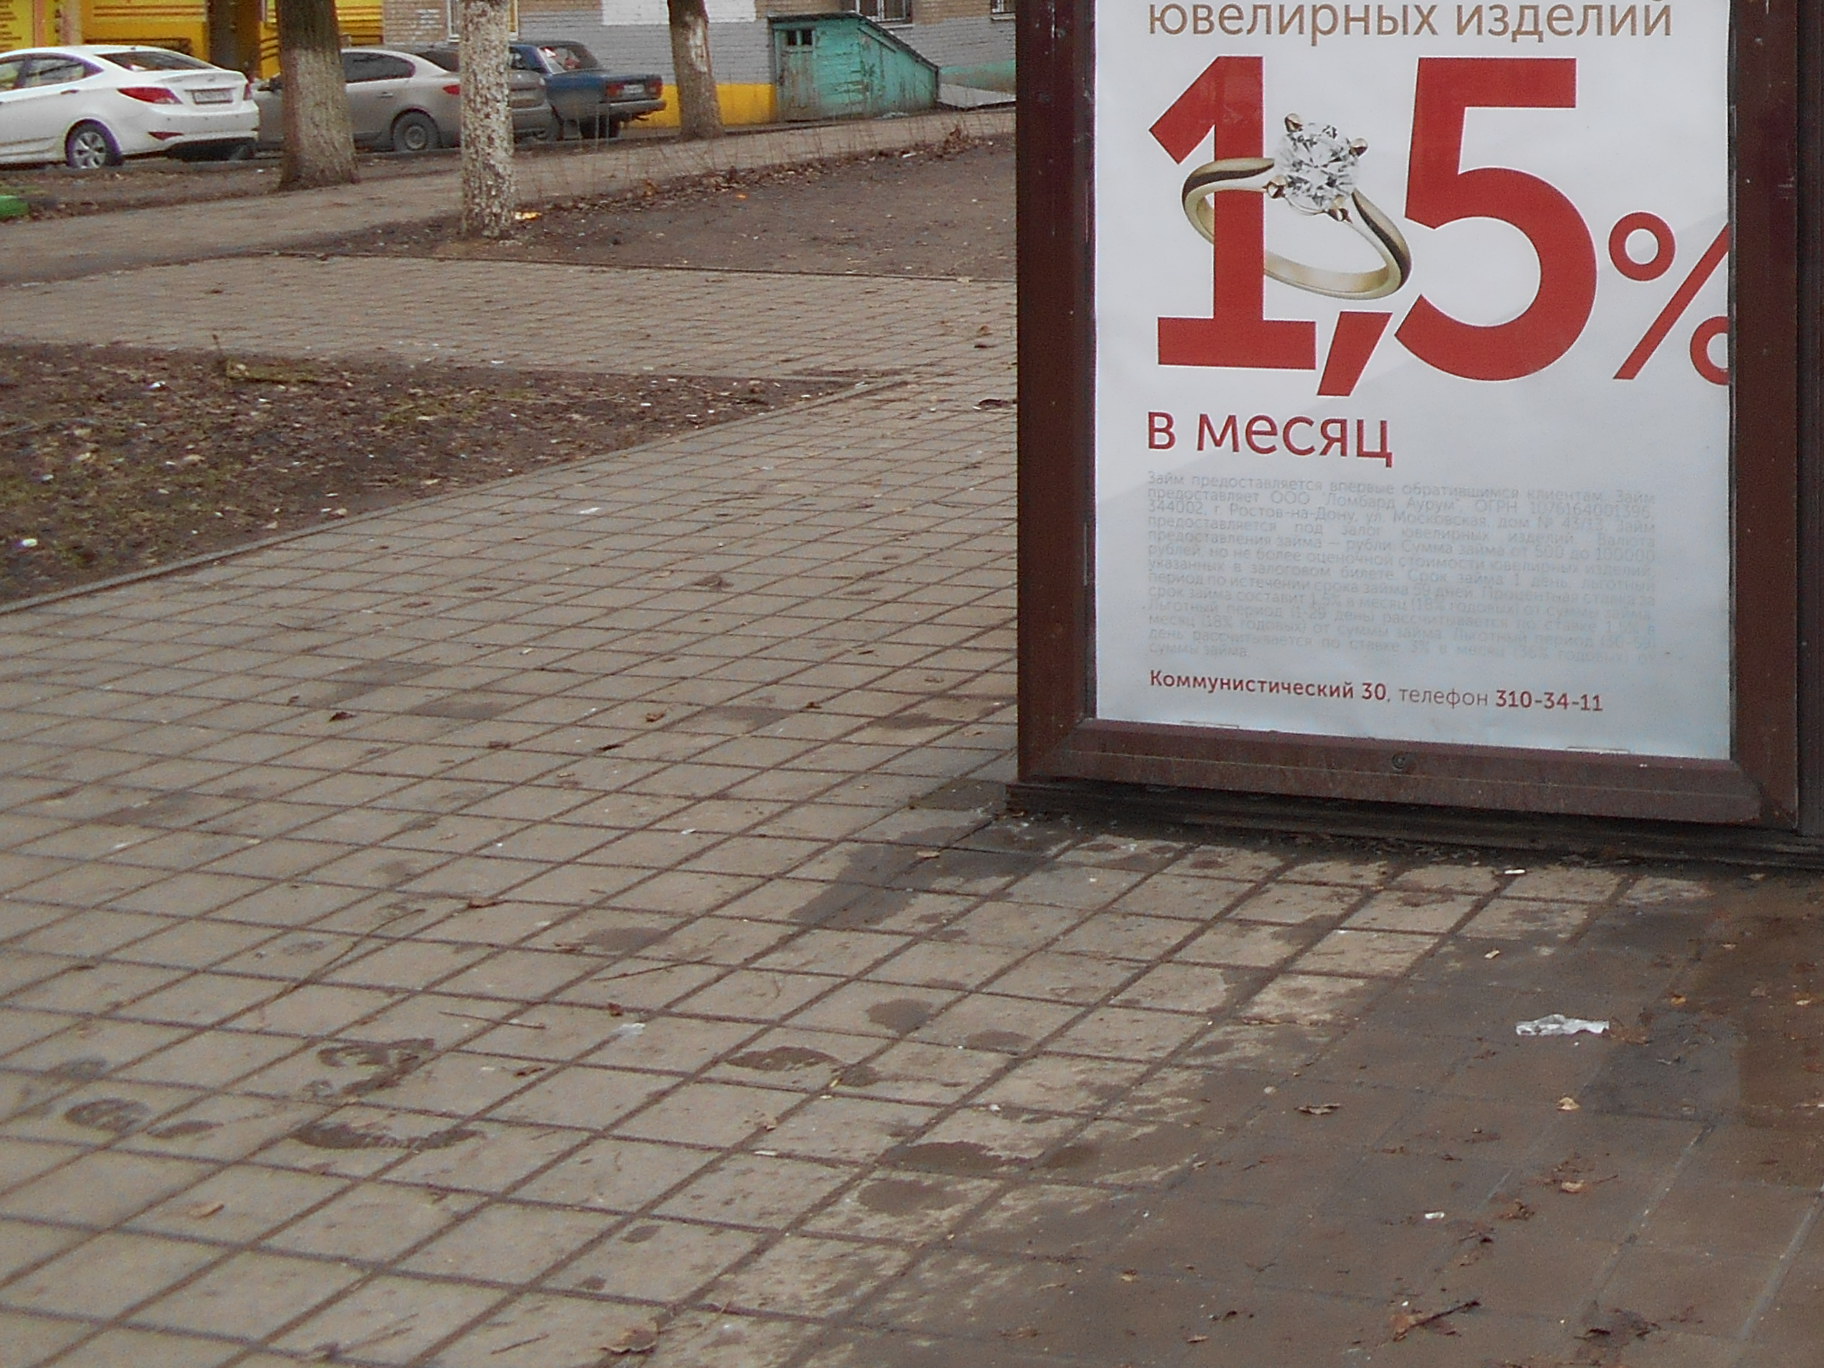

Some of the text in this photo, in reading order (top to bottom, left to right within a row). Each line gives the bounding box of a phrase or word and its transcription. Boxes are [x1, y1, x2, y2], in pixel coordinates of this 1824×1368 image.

[1149, 1, 1438, 46] ювелирных
[1147, 411, 1394, 469] в месяц
[1150, 669, 1354, 699] Коммунистический
[1399, 687, 1489, 708] телефон
[1495, 689, 1604, 712] 310-34-11
